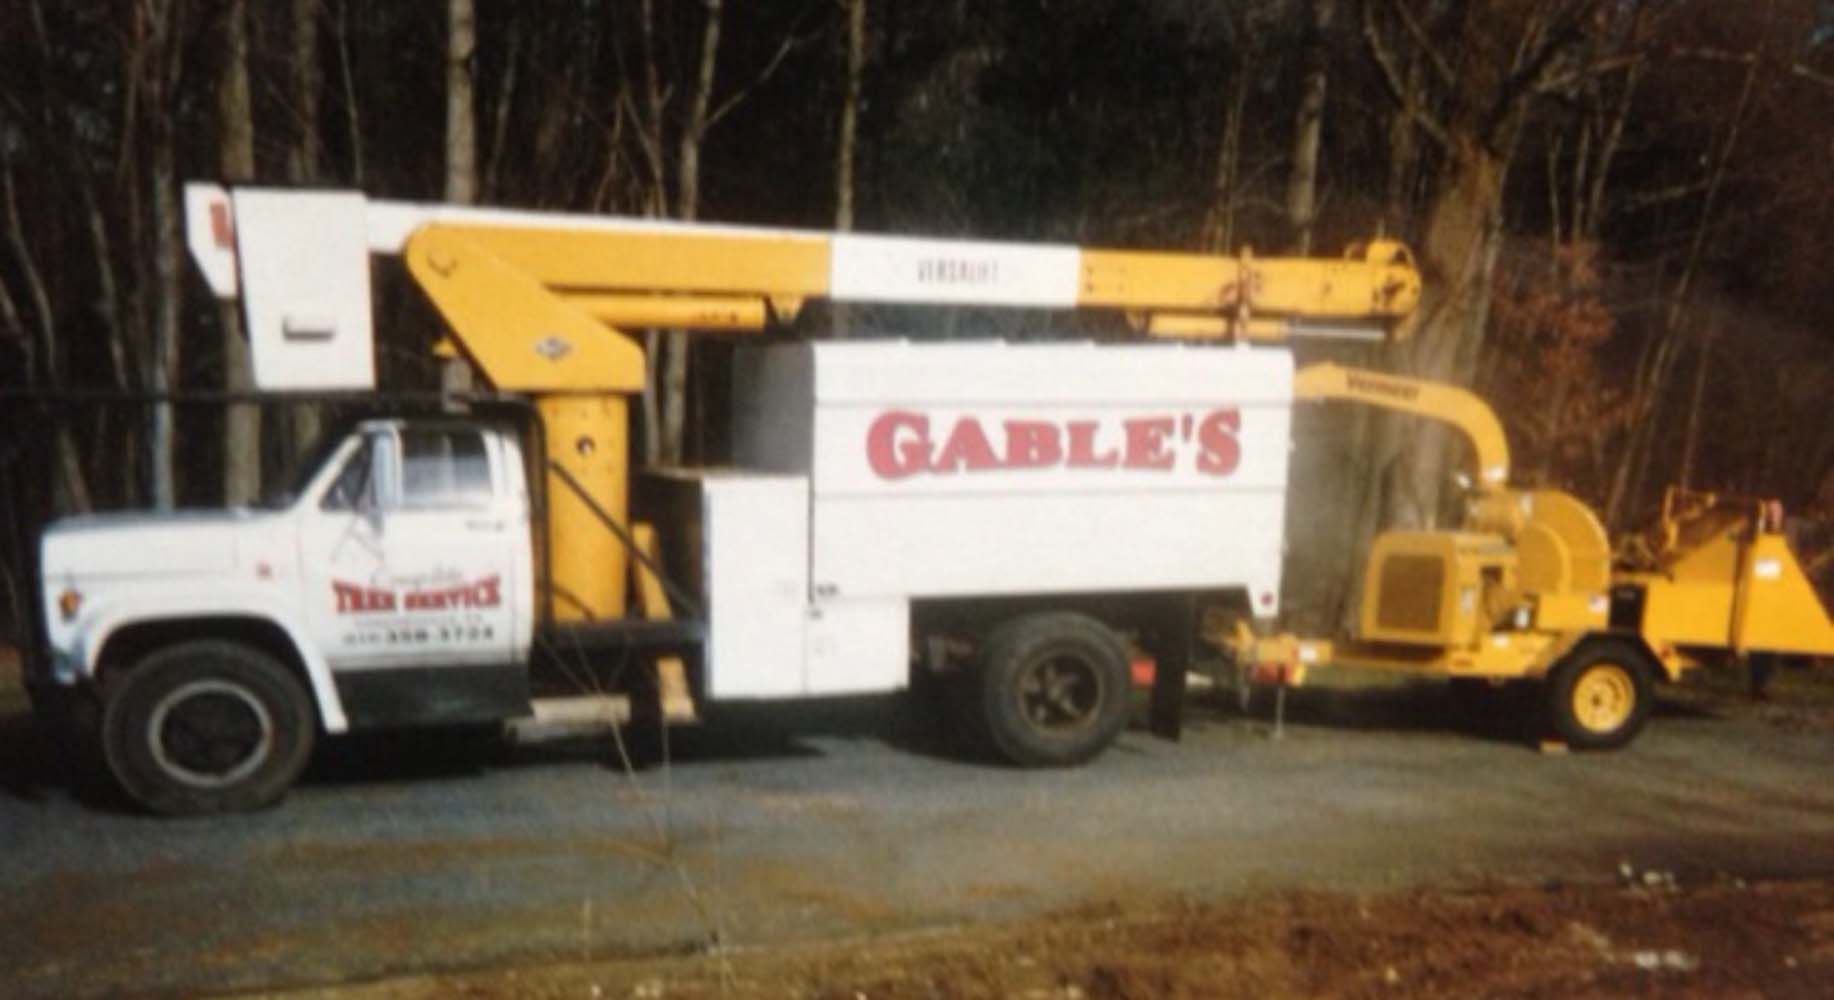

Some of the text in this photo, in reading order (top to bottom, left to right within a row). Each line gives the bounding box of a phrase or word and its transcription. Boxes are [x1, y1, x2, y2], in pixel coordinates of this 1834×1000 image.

[866, 406, 1242, 481] GABLE'S
[332, 571, 501, 614] TREE SERVICE
